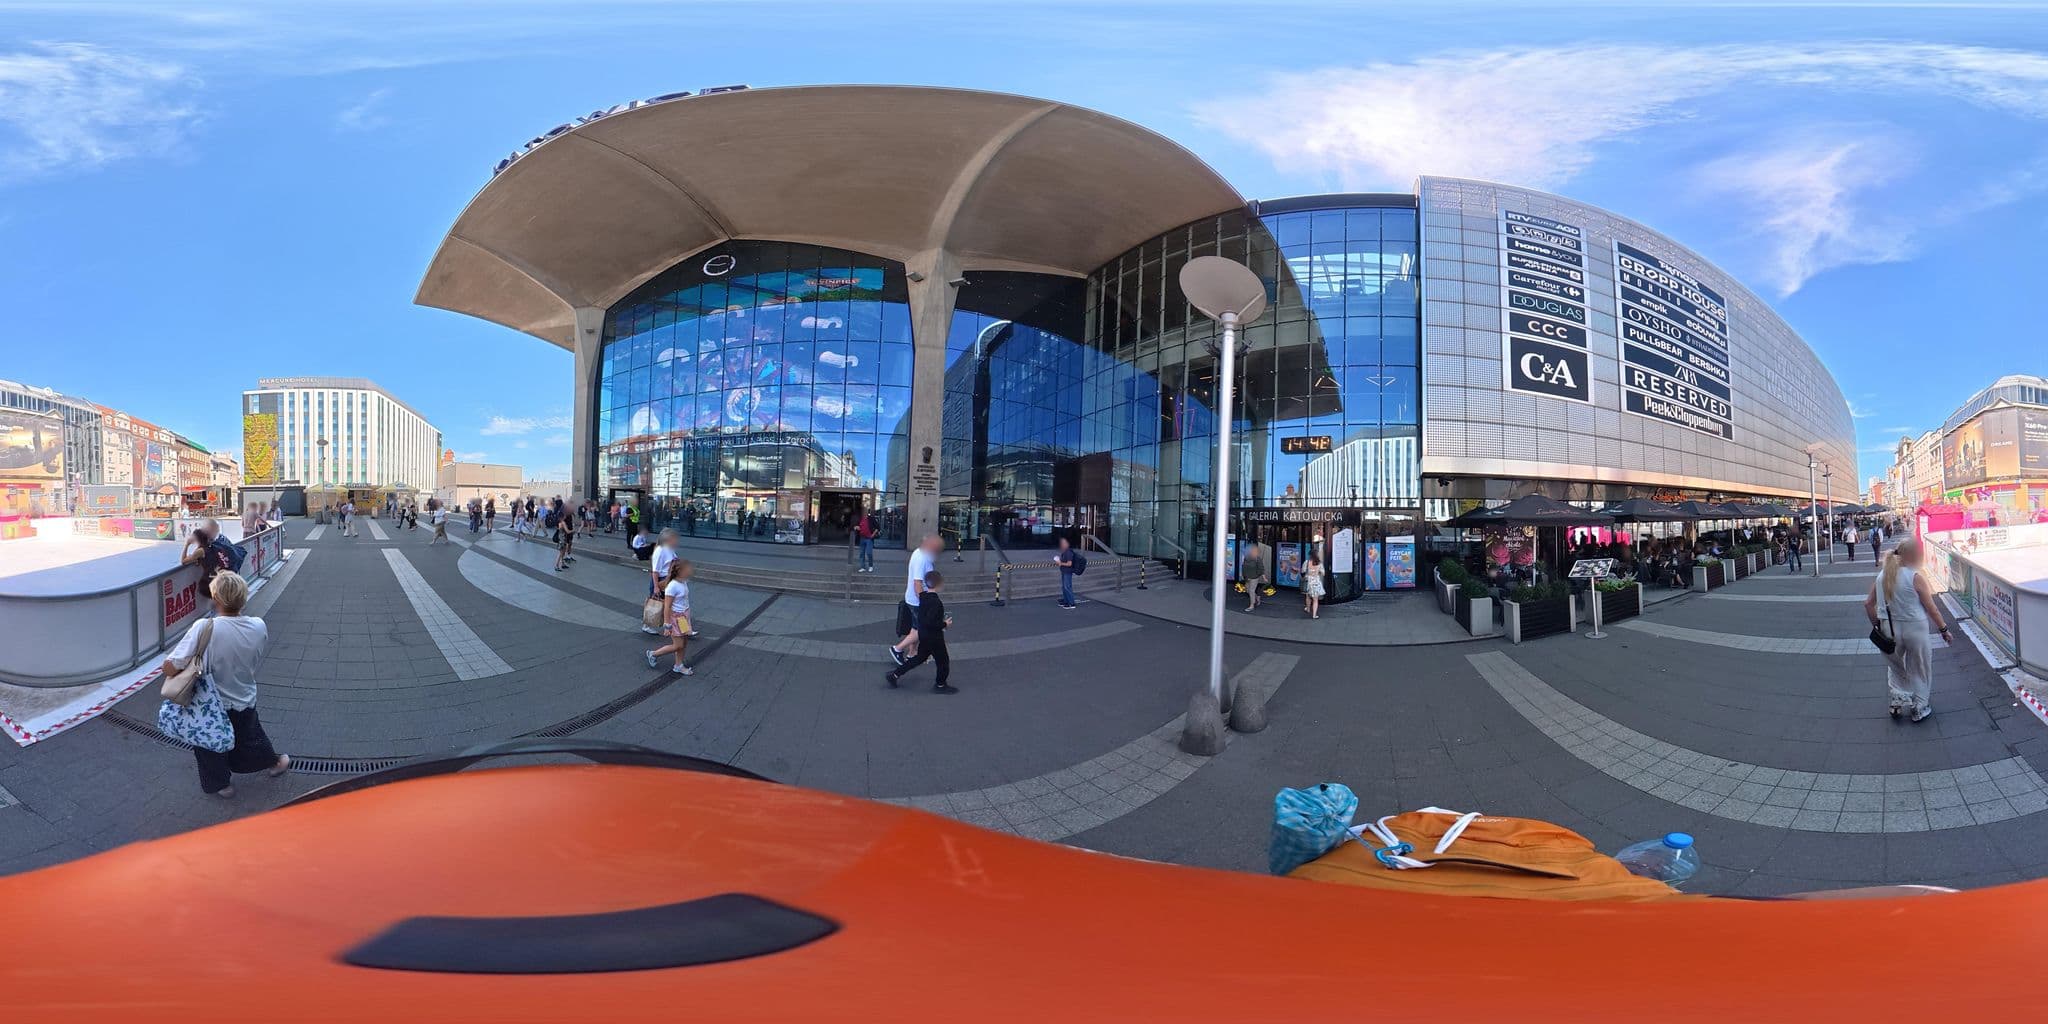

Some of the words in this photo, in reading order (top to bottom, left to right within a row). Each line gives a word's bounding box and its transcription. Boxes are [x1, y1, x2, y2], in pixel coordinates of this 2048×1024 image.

[1508, 212, 1530, 222] RTV
[1556, 225, 1579, 235] AGD
[1513, 274, 1560, 290] Carrefour
[1624, 273, 1681, 306] MOHITO
[1513, 294, 1583, 320] DOUGLAS
[1641, 298, 1668, 315] empik
[1528, 320, 1568, 339] CCC
[1629, 308, 1682, 339] OYSHO
[1630, 328, 1683, 358] PULL&BEAR
[1689, 354, 1727, 380] BERSHKA
[1521, 352, 1578, 389] C&A
[1674, 364, 1698, 386] ZARA
[1634, 370, 1727, 417] RESERVED
[1644, 396, 1723, 437] Peek&Cloppenburg
[1249, 511, 1278, 521] GALERIA
[1283, 511, 1342, 521] KATOWICKA
[166, 582, 196, 616] BABY
[166, 599, 196, 627] BURGERS
